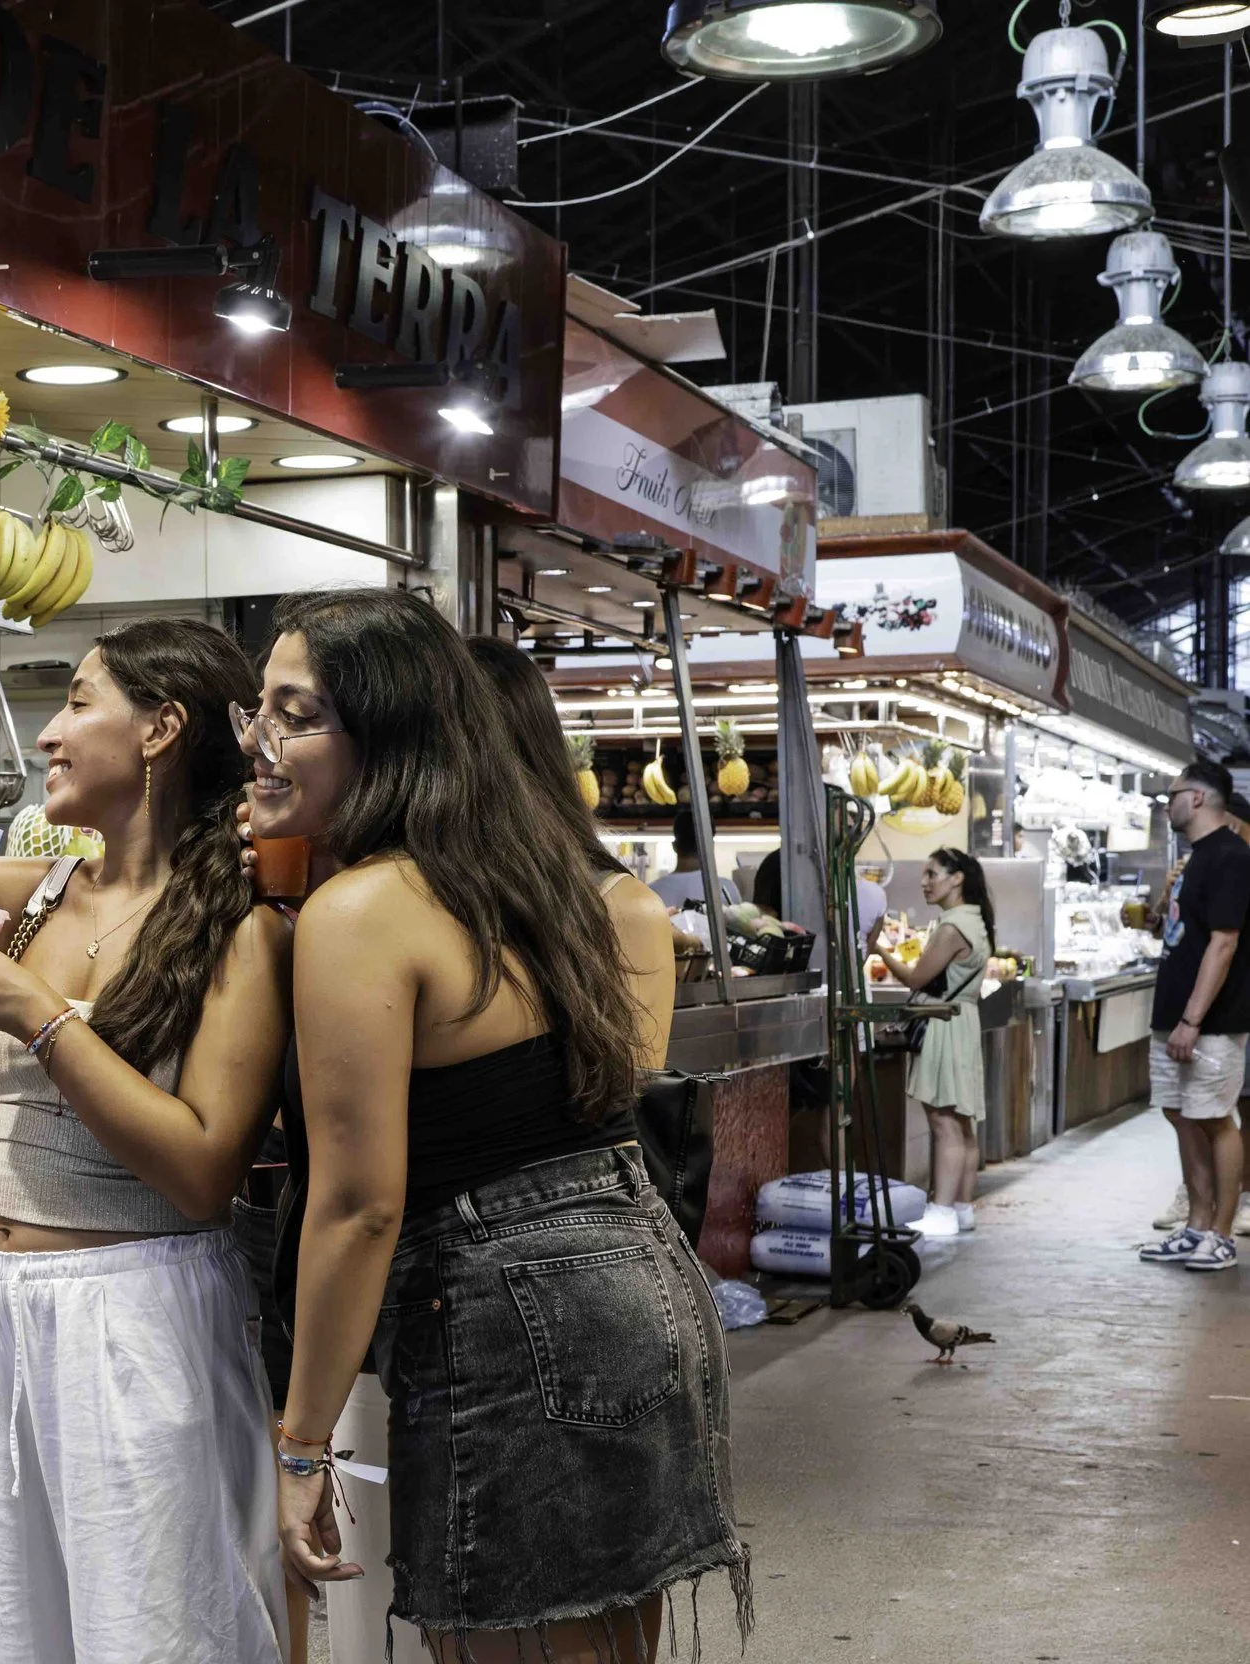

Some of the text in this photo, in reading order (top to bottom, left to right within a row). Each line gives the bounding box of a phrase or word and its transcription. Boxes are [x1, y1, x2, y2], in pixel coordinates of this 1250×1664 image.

[146, 102, 262, 247] LA
[309, 186, 522, 407] TERRA
[616, 442, 671, 509] Fruits
